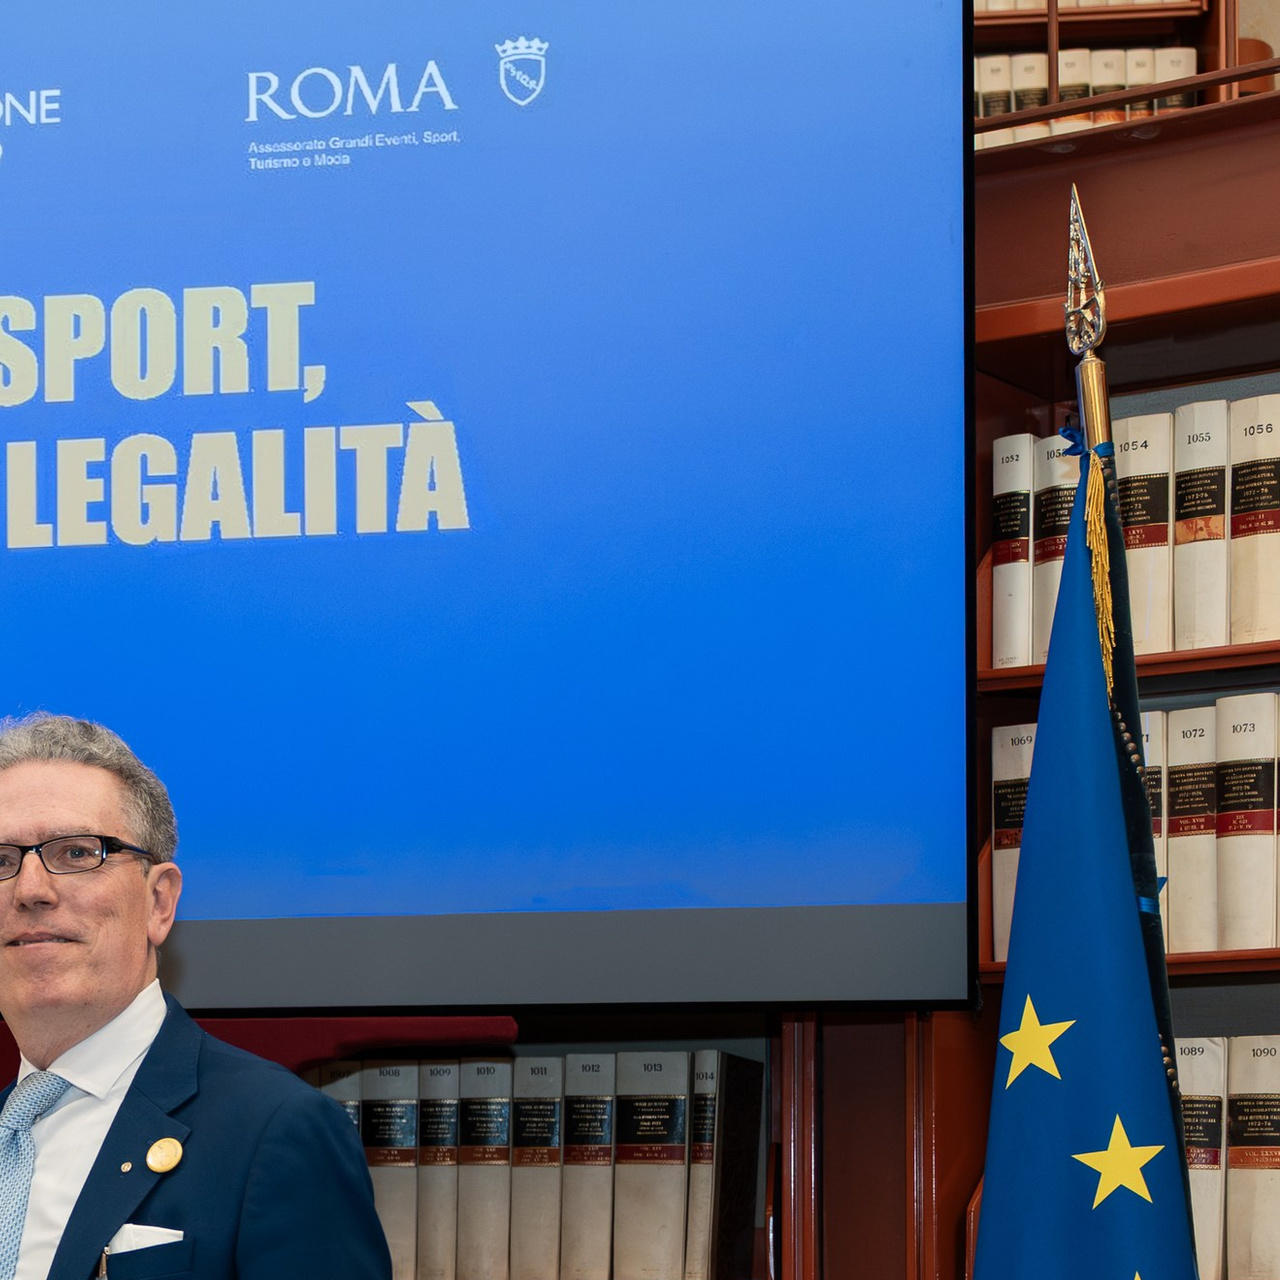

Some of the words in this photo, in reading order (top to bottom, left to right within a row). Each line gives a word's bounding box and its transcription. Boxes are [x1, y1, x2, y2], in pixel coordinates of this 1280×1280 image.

[245, 60, 459, 121] ROMA
[248, 139, 326, 154] Assessorato
[328, 134, 372, 149] Grandi
[375, 131, 419, 148] Eventi,
[423, 130, 461, 145] Sport,
[248, 156, 299, 170] Turismo
[302, 158, 311, 167] e
[314, 153, 350, 167] Moda
[1244, 423, 1273, 437] 1056
[1187, 432, 1211, 445] 1055
[1119, 440, 1148, 453] 1054
[1000, 454, 1020, 465] 1052
[3, 400, 471, 550] LEGALITÀ
[1181, 727, 1205, 739] 1072
[1232, 723, 1256, 734] 1073
[1010, 735, 1033, 747] 1069
[1180, 1046, 1205, 1056] 1089
[1252, 1047, 1277, 1058] 1090
[379, 1067, 400, 1077] 1008
[429, 1068, 451, 1077] 1009
[476, 1066, 495, 1076] 1010
[530, 1067, 547, 1076] 1011
[581, 1064, 600, 1073] 1012
[643, 1063, 662, 1072] 1013
[695, 1072, 714, 1081] 1014
